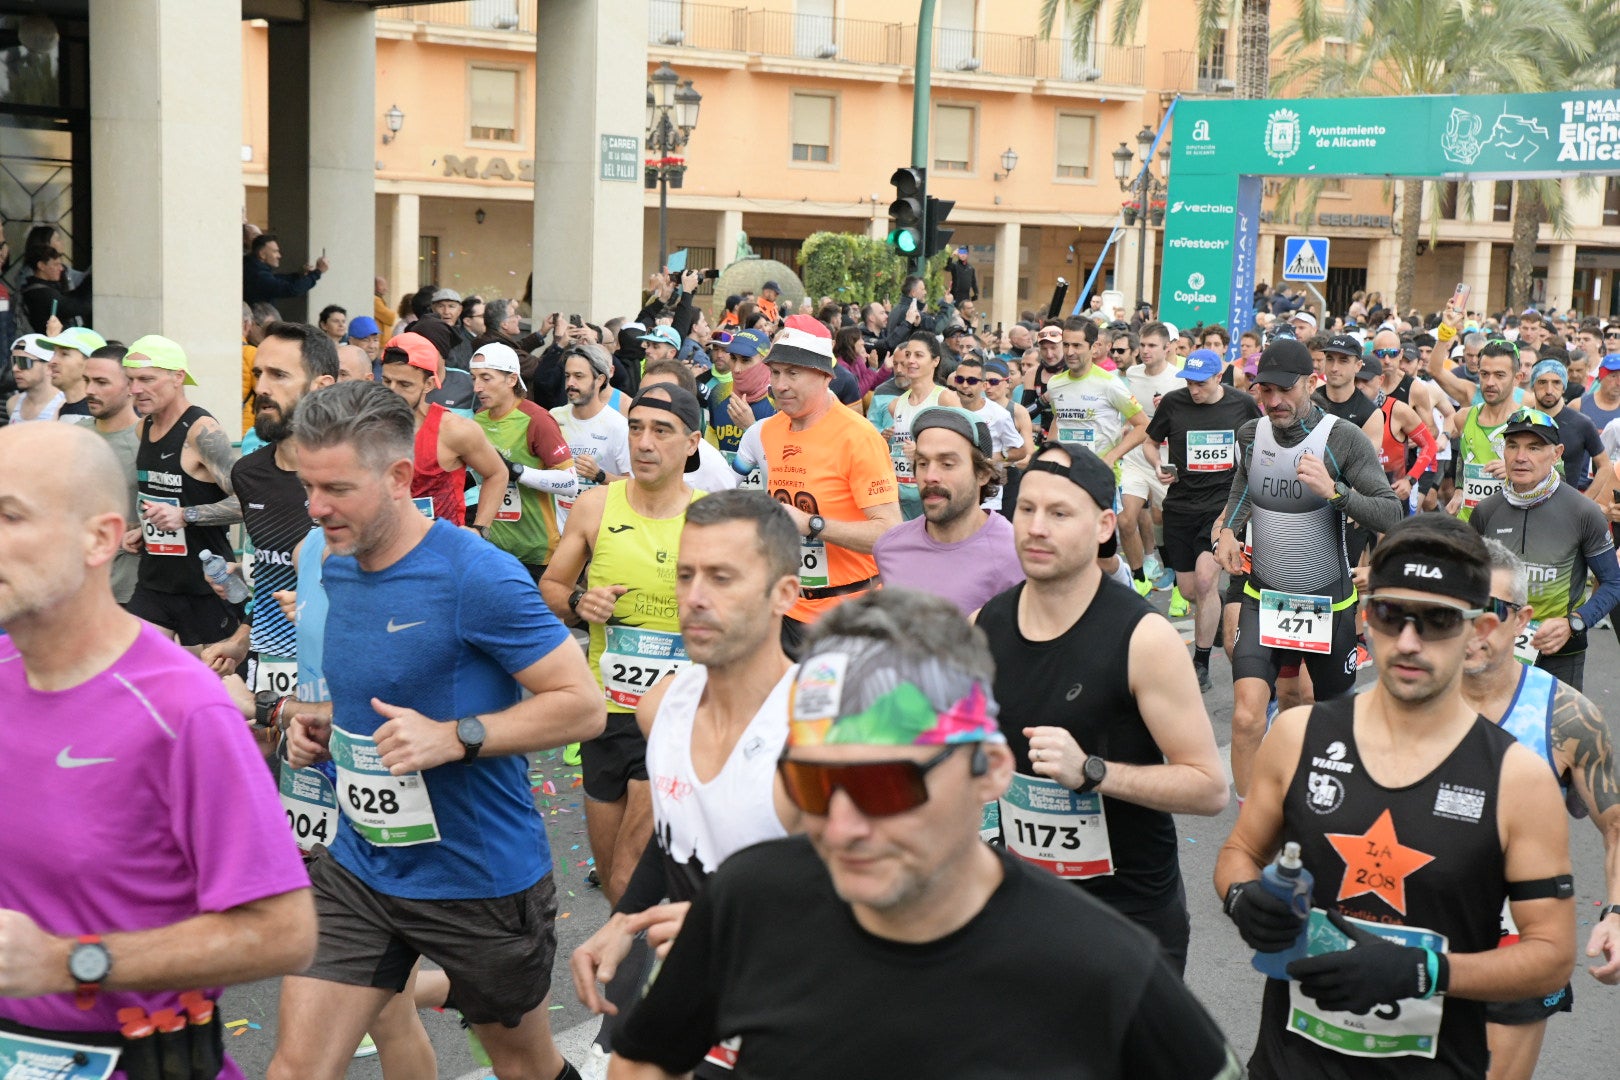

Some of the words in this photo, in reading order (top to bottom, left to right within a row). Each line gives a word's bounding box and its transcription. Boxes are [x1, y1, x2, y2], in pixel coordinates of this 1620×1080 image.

[1308, 125, 1386, 138] Ayuntamiento
[1559, 122, 1620, 143] Elch
[609, 137, 636, 150] CARRER
[1316, 138, 1330, 147] de
[1332, 137, 1377, 147] Alicante
[604, 163, 615, 177] DEL
[616, 163, 635, 178] PALAU
[1184, 203, 1234, 214] vectalia
[1319, 211, 1391, 228] SEGUROS
[1174, 290, 1217, 304] Coplaca
[1194, 449, 1228, 460] 3665
[1261, 476, 1303, 500] FURIO
[1403, 563, 1443, 579] FILA
[1277, 617, 1313, 634] 471
[1440, 782, 1451, 790] LA
[1452, 784, 1487, 797] DEVESA
[347, 783, 400, 815] 628
[1014, 818, 1081, 850] 1173
[1366, 840, 1392, 860] LA
[1355, 868, 1396, 890] 208
